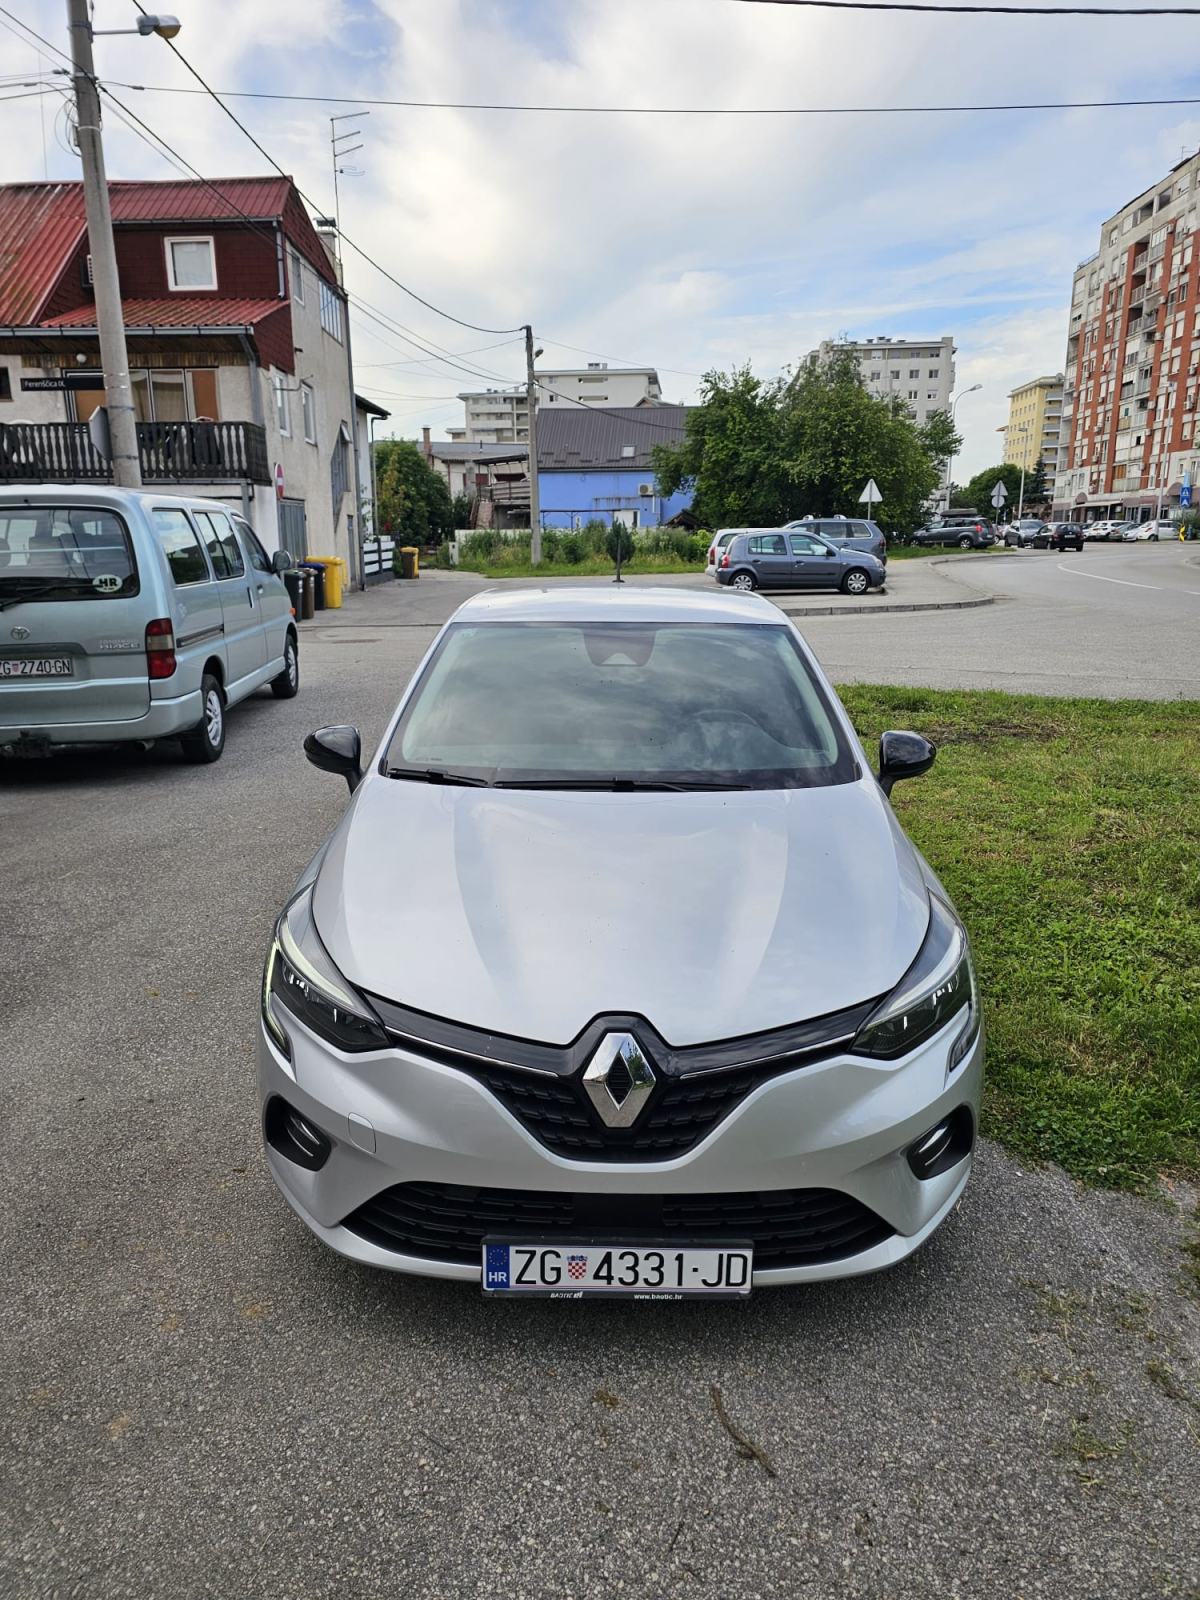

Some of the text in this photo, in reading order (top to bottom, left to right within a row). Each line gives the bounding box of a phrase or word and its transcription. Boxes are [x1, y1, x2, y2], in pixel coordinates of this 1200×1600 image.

[99, 577, 118, 587] HR
[515, 1249, 562, 1286] ZG
[488, 1271, 507, 1282] HR
